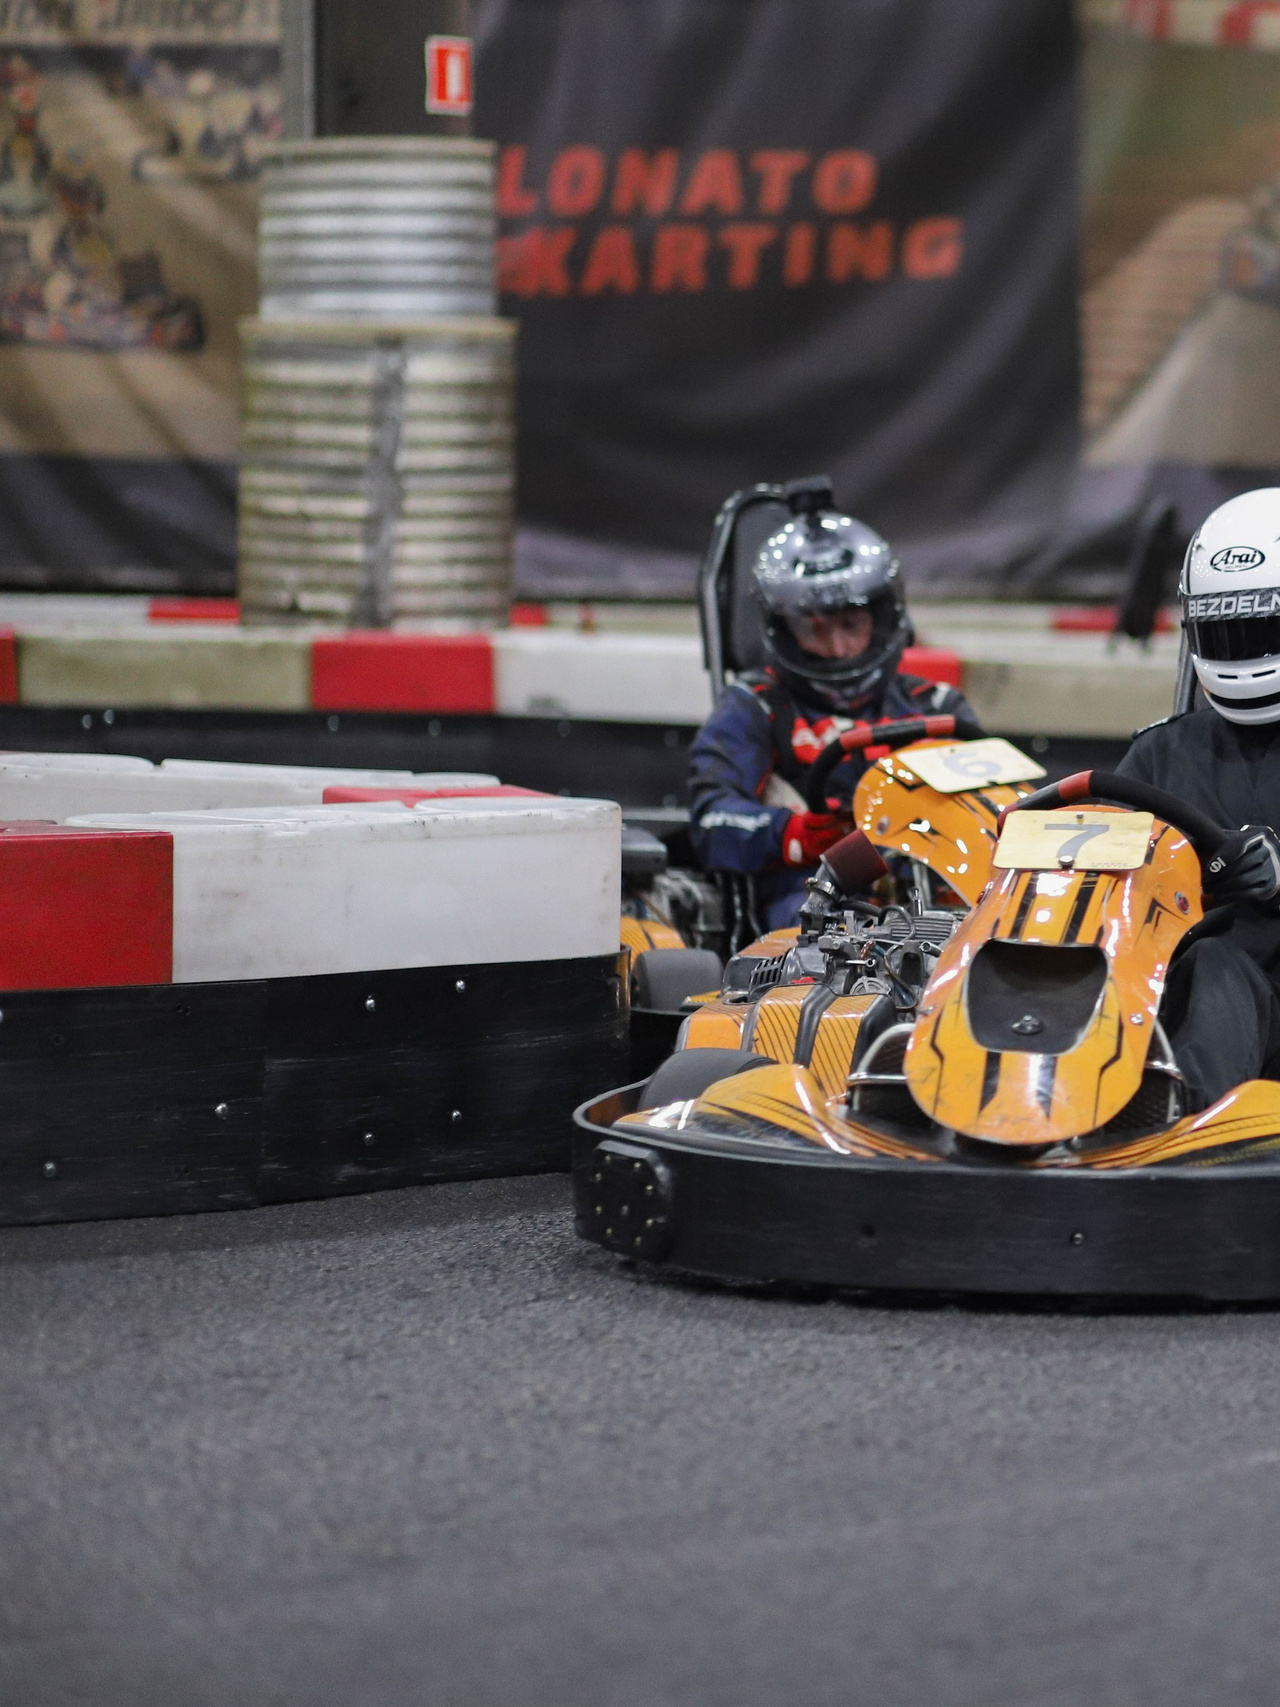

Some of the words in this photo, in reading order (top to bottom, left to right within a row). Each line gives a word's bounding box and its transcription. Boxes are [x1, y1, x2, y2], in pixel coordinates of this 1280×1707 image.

[505, 216, 963, 296] KARTING
[1213, 550, 1257, 566] Arai
[943, 752, 1002, 777] 6
[1044, 823, 1110, 859] 7
